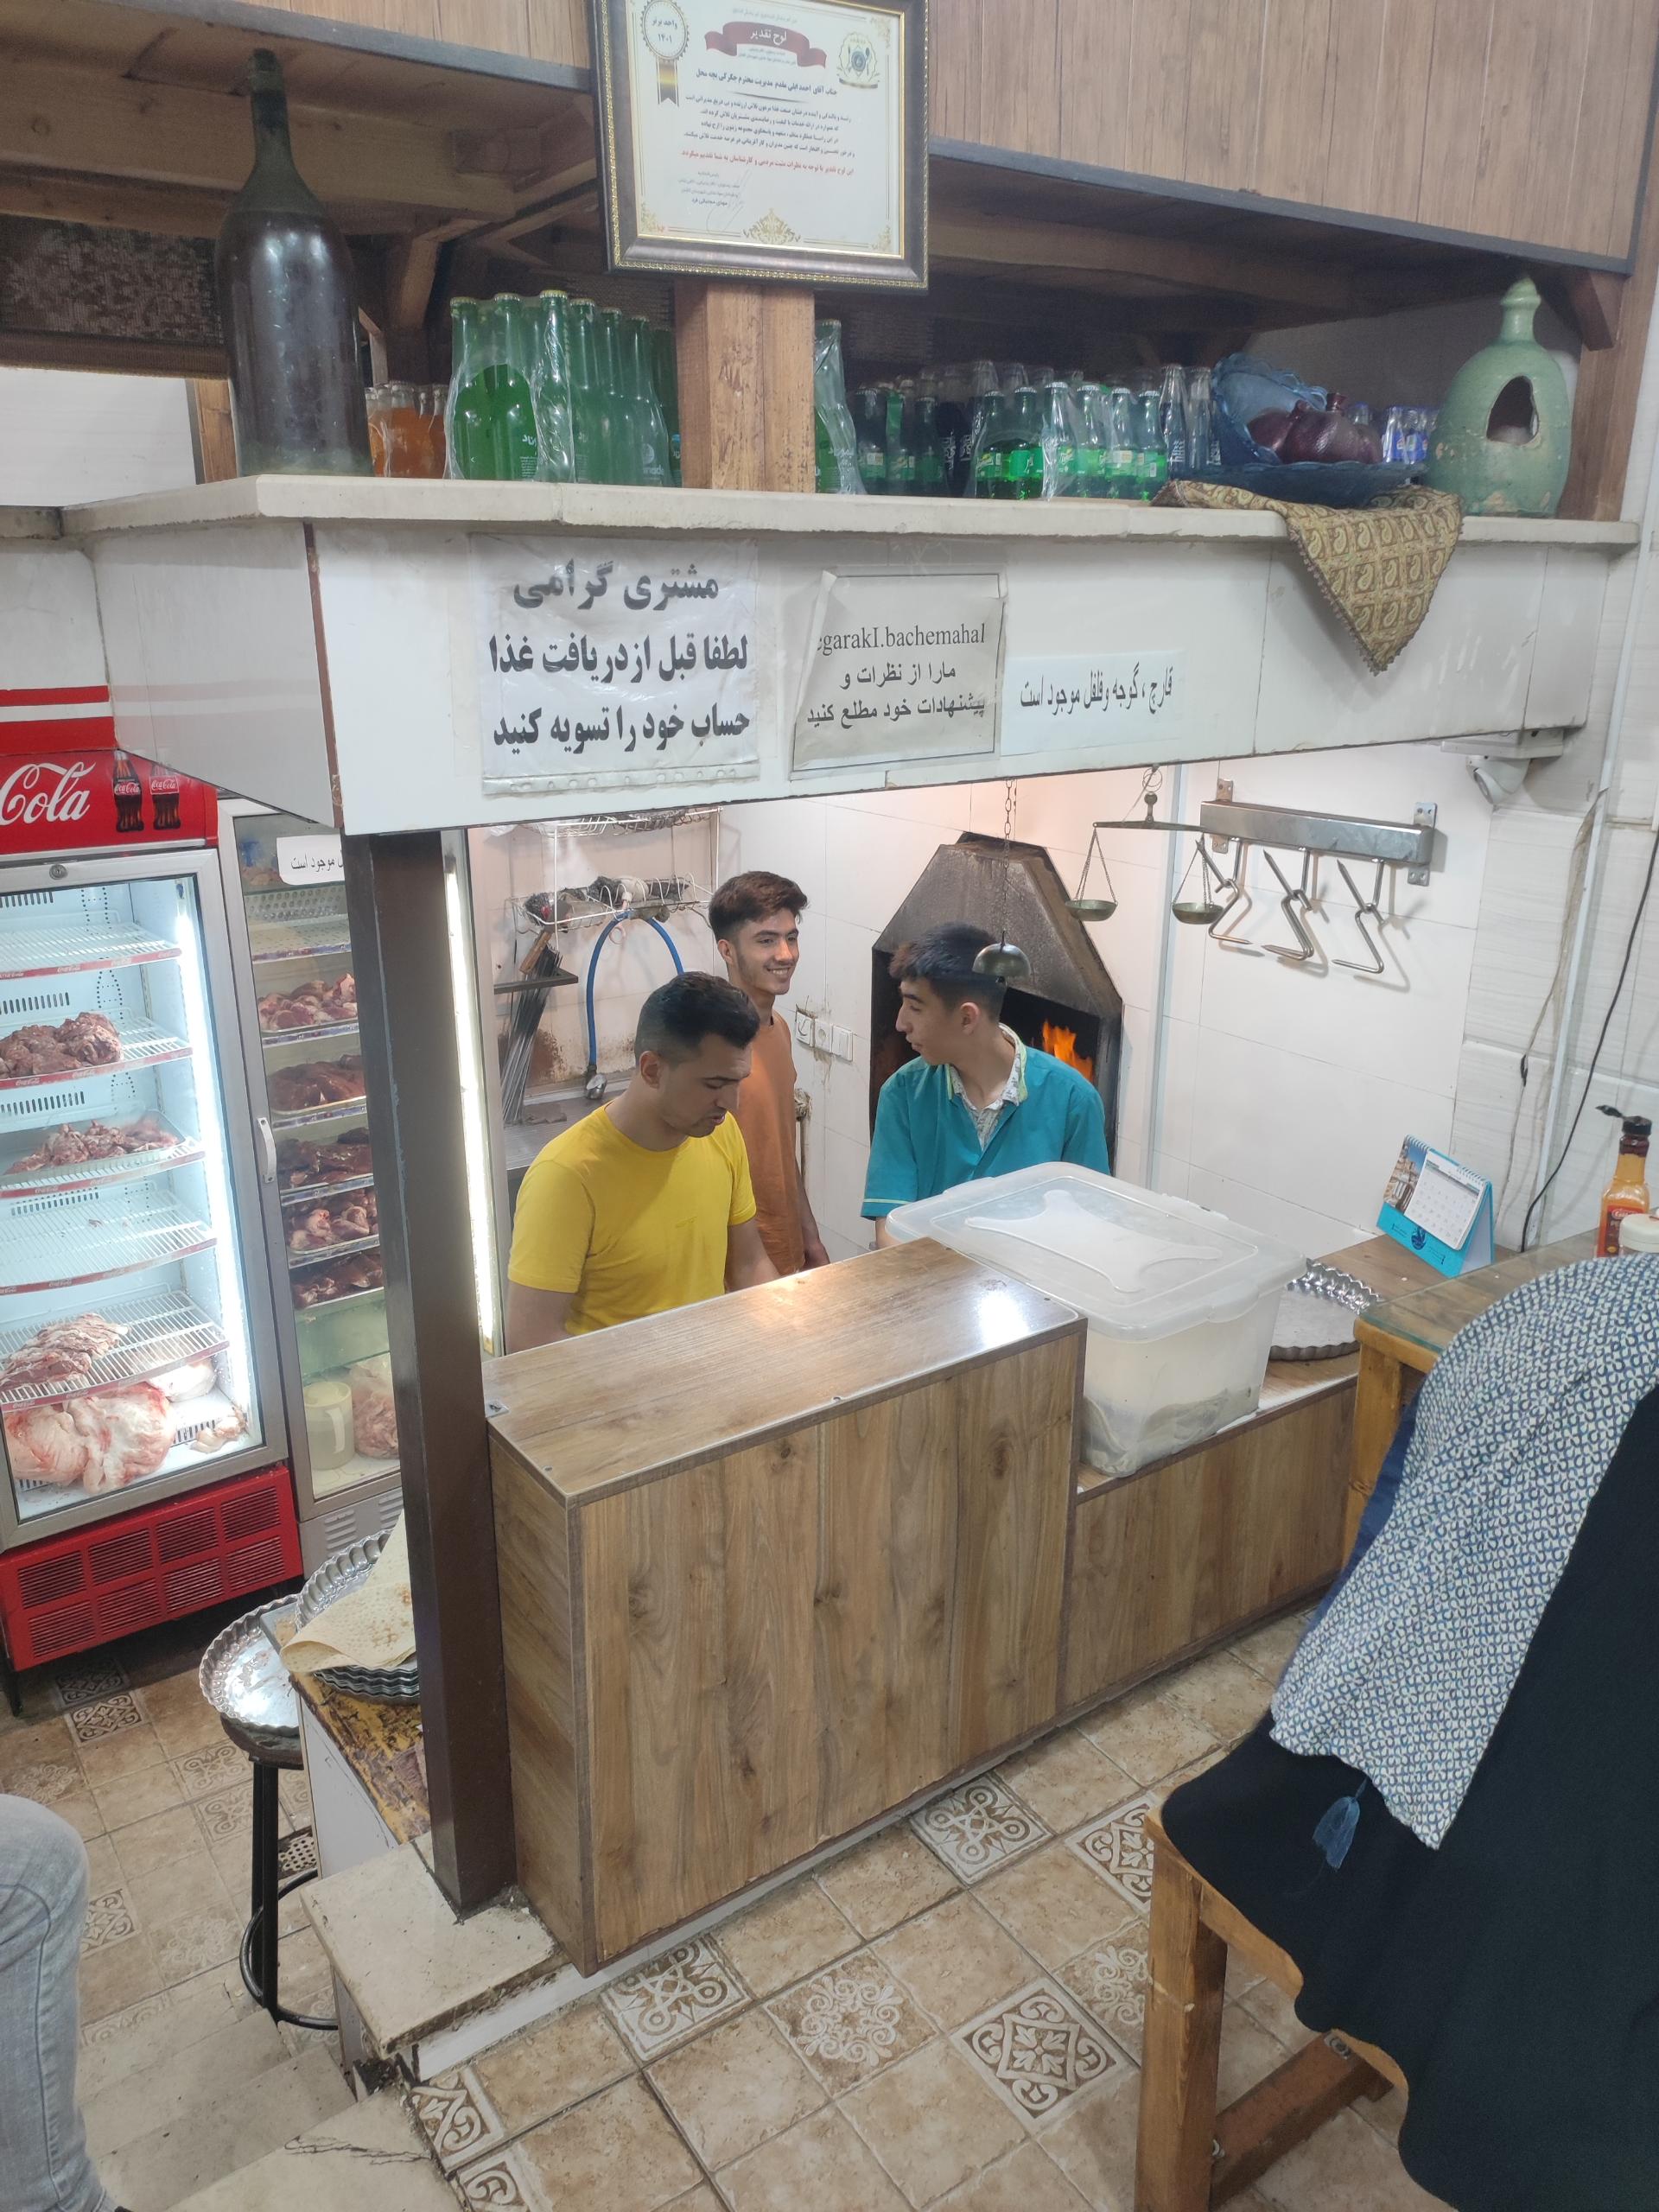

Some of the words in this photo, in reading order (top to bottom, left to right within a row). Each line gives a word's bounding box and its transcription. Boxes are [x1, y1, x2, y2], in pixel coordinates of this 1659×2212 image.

[750, 28, 772, 41] تقدیر
[772, 29, 787, 46] لوح
[513, 558, 613, 609] گرامی
[623, 563, 719, 611] مشتری
[489, 632, 534, 673] غذا
[542, 632, 629, 683] دریافت
[630, 633, 651, 683] از
[658, 632, 696, 682] قبل
[703, 633, 748, 671] لطفا
[839, 672, 851, 690] و
[857, 662, 902, 688] نظرات
[908, 663, 921, 685] از
[1020, 674, 1045, 707] است
[1112, 661, 1140, 709] گوجه
[807, 703, 835, 728] کنید
[841, 699, 878, 729] مطلع
[884, 697, 912, 721] خود
[917, 692, 985, 718] پیشنهادات
[1047, 683, 1080, 715] موجود
[493, 707, 543, 755] کنید
[550, 705, 609, 754] تسویه
[615, 704, 636, 752] را
[643, 702, 684, 751] خود
[691, 702, 750, 747] حساب
[290, 852, 308, 869] است
[311, 857, 335, 873] موجود
